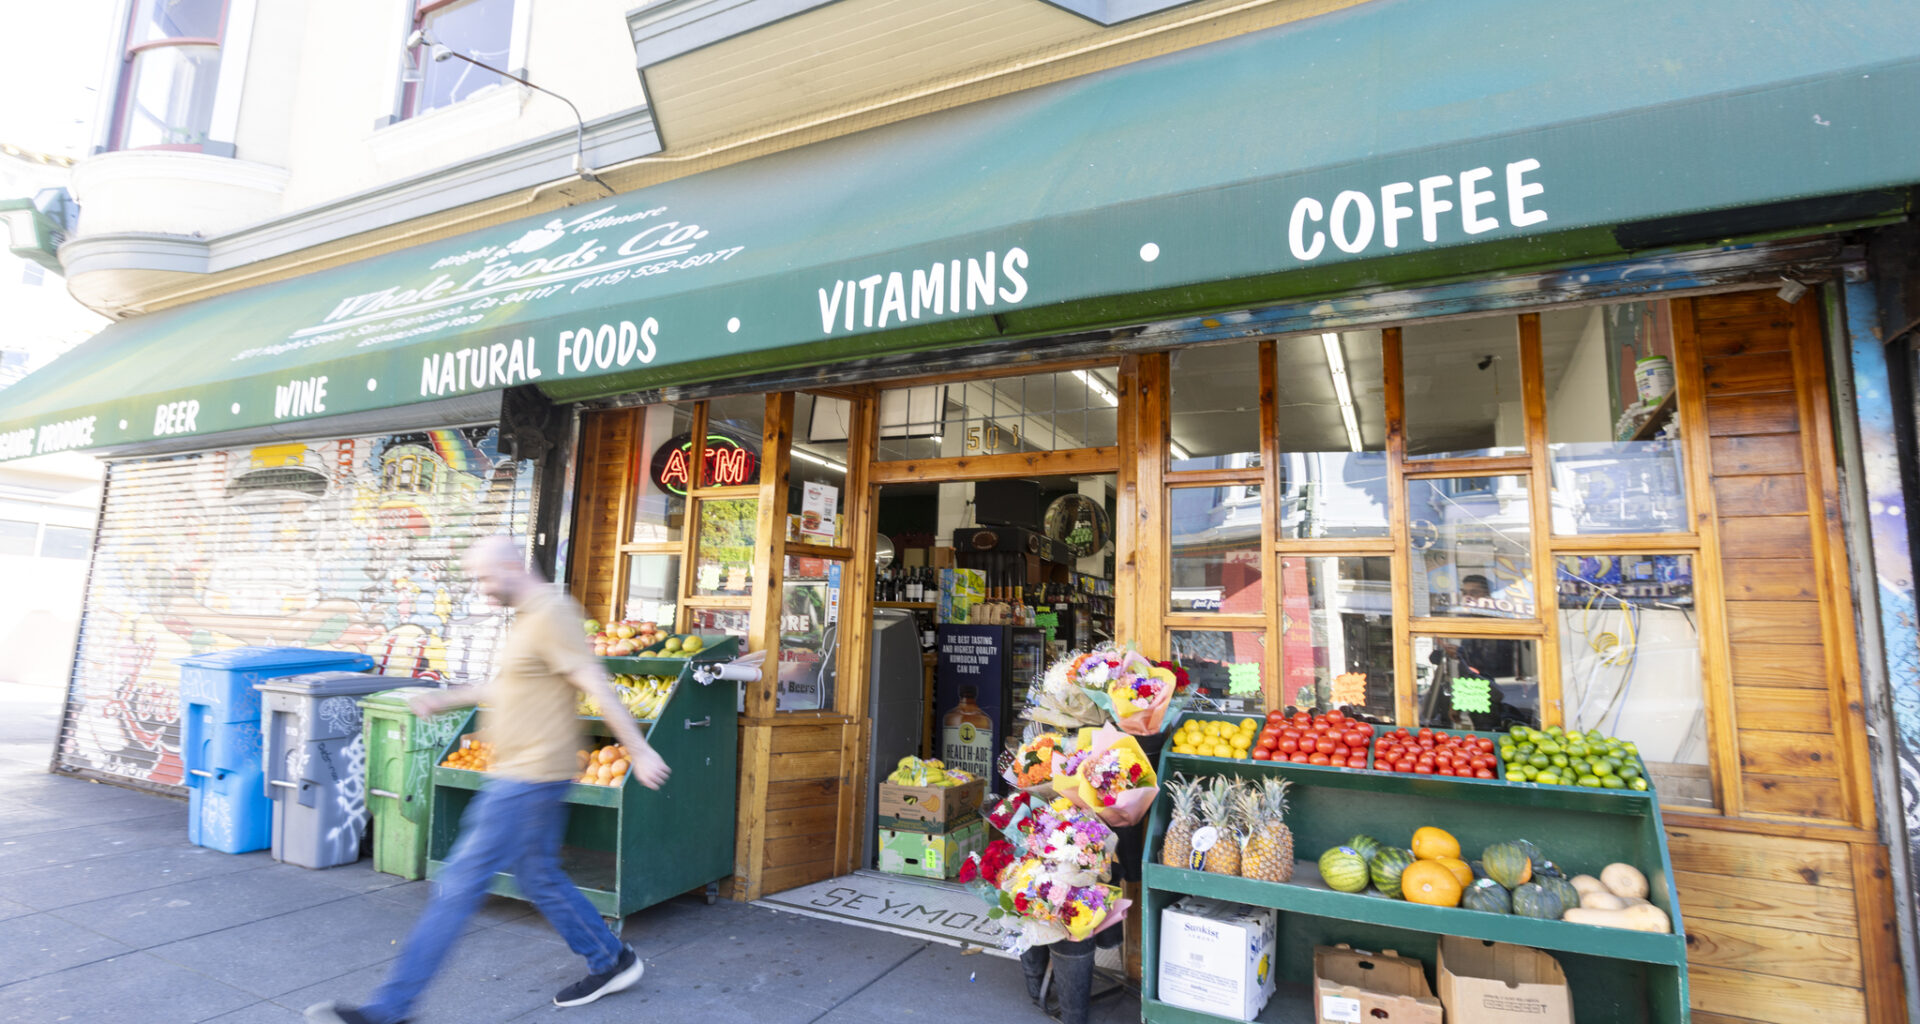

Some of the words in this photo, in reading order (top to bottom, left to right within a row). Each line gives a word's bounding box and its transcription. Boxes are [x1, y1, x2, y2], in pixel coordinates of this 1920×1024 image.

[572, 206, 669, 235] Fillmore
[1288, 158, 1548, 261] COFFEE
[322, 274, 455, 323] Whole
[452, 239, 607, 293] Foods
[617, 221, 709, 257] Co.
[498, 283, 566, 306] 94117
[570, 269, 631, 294] (415)
[630, 245, 746, 280] 552-6077
[818, 247, 1029, 335] VITAMINS
[420, 336, 542, 396] NATURAL
[557, 317, 659, 375] FOODS
[274, 375, 329, 419] WINE
[153, 400, 200, 436] BEER
[36, 415, 97, 455] PRODUCE
[967, 424, 1019, 450] 501
[942, 645, 953, 653] AND
[954, 645, 974, 654] HIGHEST
[976, 646, 997, 655] QUALITY
[947, 635, 957, 645] THE
[958, 635, 970, 645] BEST
[971, 635, 993, 645] TASTING
[950, 654, 978, 664] KOMBUCHA
[978, 655, 989, 665] YOU
[957, 665, 968, 673] CAN
[946, 744, 989, 762] HEALTH-ADE
[1184, 922, 1219, 939] Sunkist
